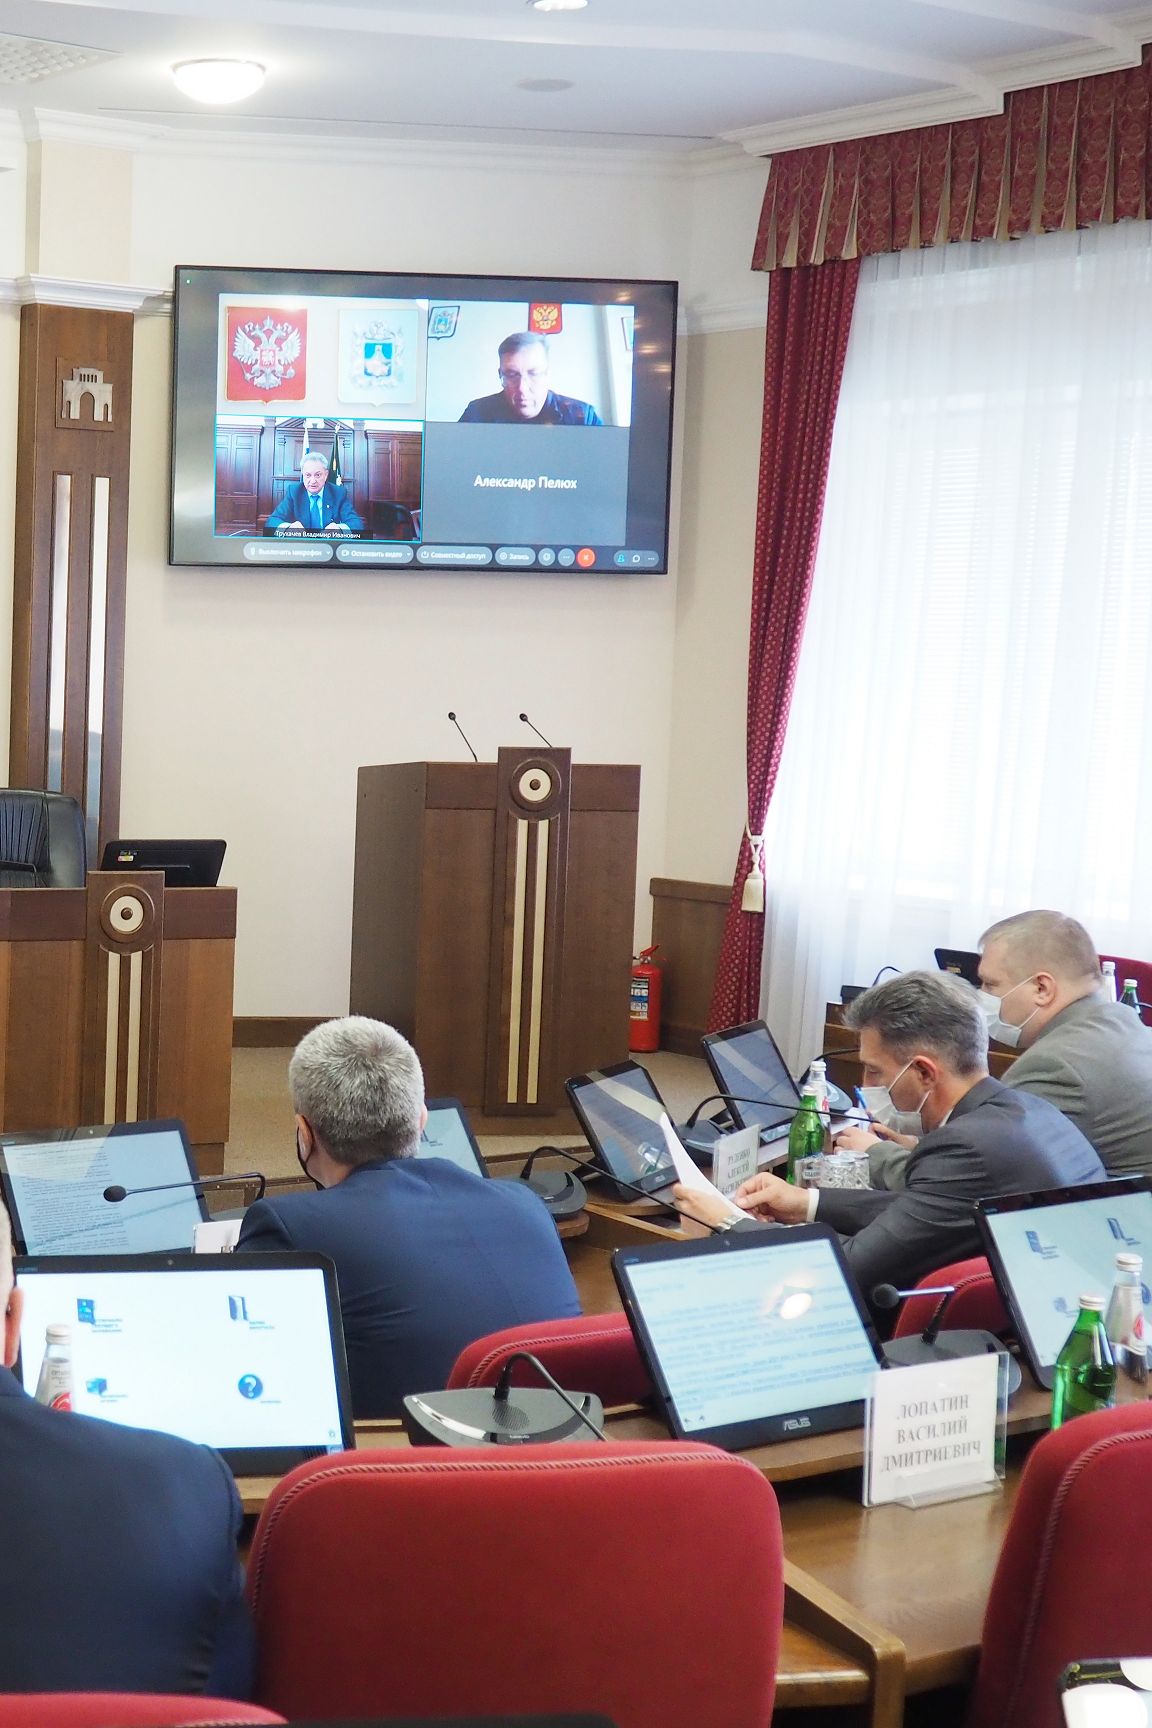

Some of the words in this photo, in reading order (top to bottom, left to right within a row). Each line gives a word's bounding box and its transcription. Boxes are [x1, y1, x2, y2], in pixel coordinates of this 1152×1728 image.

[474, 475, 536, 491] Александр
[538, 476, 578, 489] Пелюх
[302, 530, 331, 539] Владимир
[896, 1394, 969, 1420] ЛОПАТИН
[783, 1416, 811, 1431] ASUS
[897, 1416, 968, 1444] ВАСИЛИЙ
[880, 1440, 981, 1473] ДМИТРИЕВИЧ
